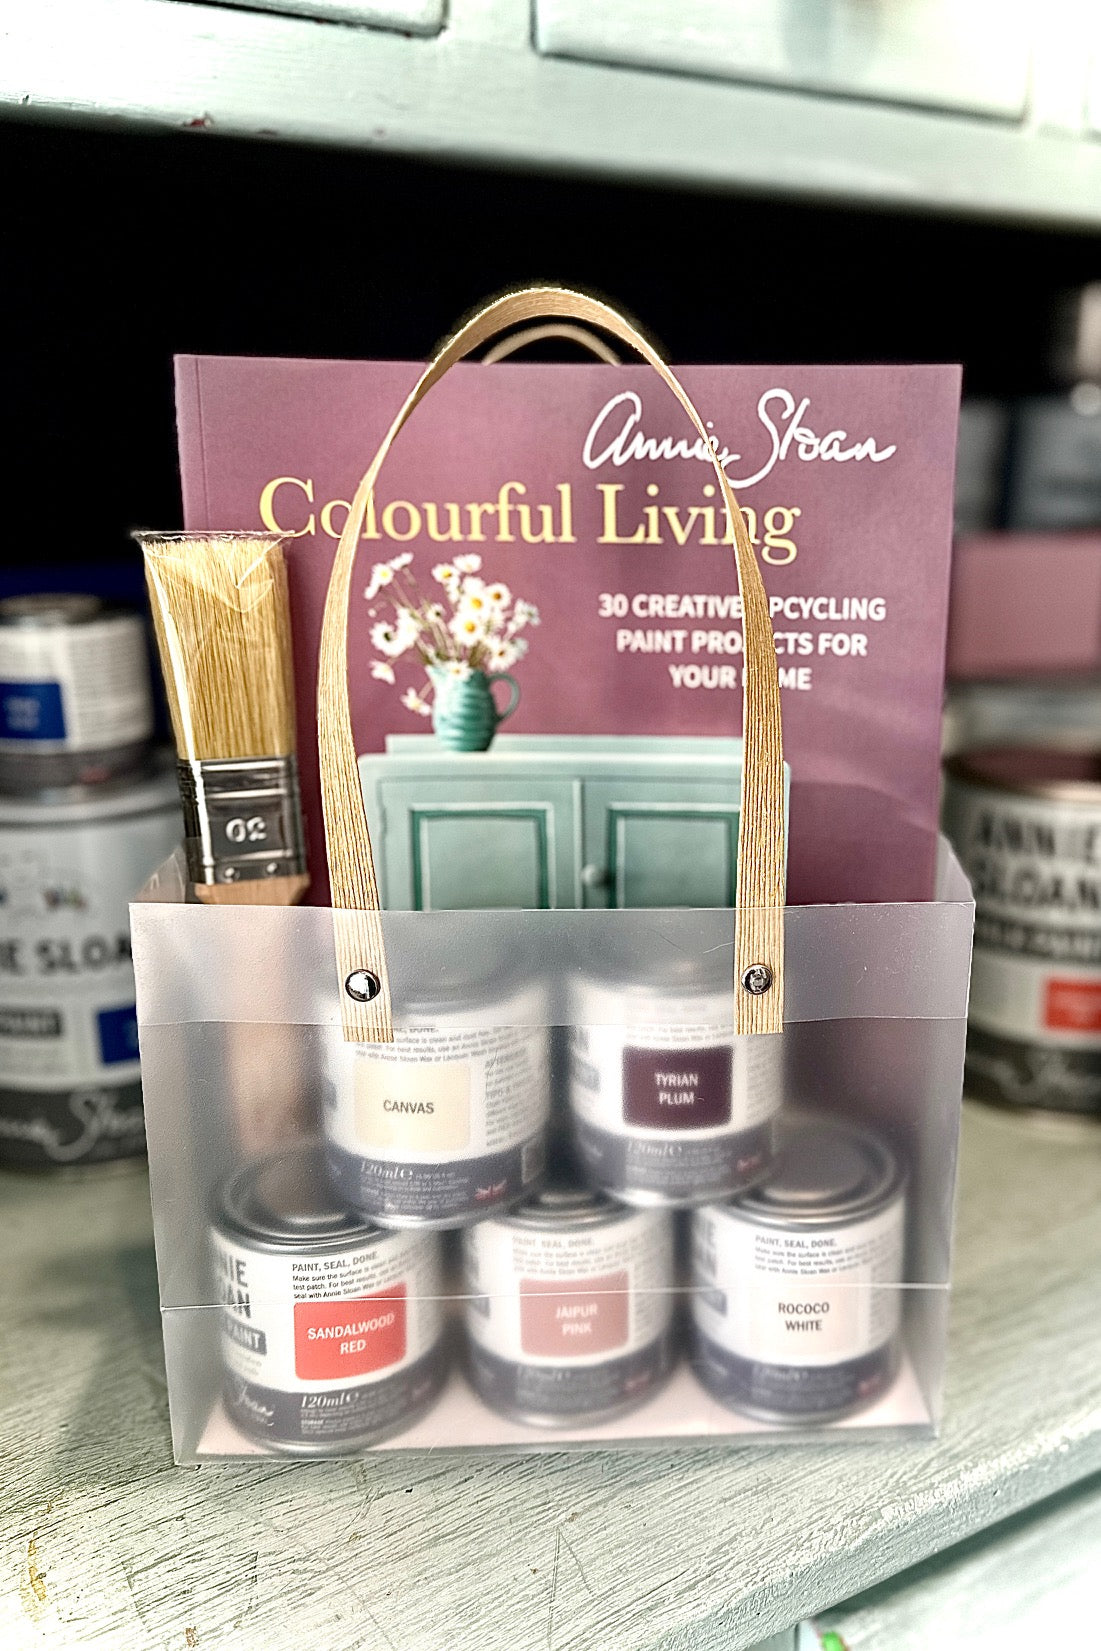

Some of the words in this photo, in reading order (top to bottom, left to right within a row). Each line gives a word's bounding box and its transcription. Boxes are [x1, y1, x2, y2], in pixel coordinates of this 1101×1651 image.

[583, 391, 729, 468] Annie
[720, 388, 897, 489] Sloan
[259, 477, 577, 543] Colourful
[597, 484, 801, 565] Living
[599, 594, 628, 617] 30
[632, 595, 744, 619] CREATIVE
[768, 597, 887, 621] PCYCLING
[616, 629, 688, 652] PAINT
[691, 631, 813, 656] PROCTS
[818, 633, 868, 656] FOR
[669, 665, 736, 689] YOUR
[741, 666, 812, 690] ME
[655, 1072, 698, 1087] TYRIAN
[659, 1091, 694, 1104] PLUM
[383, 1099, 435, 1115] CANVAS
[292, 1263, 321, 1272] PAINT,
[324, 1260, 351, 1270] SEAL,
[556, 1303, 597, 1319] JAIPUR
[778, 1302, 830, 1314] ROCOCO
[307, 1313, 396, 1340] SANDALWOOD
[562, 1323, 592, 1336] PINK
[785, 1320, 823, 1331] WHITE
[340, 1339, 367, 1355] RED
